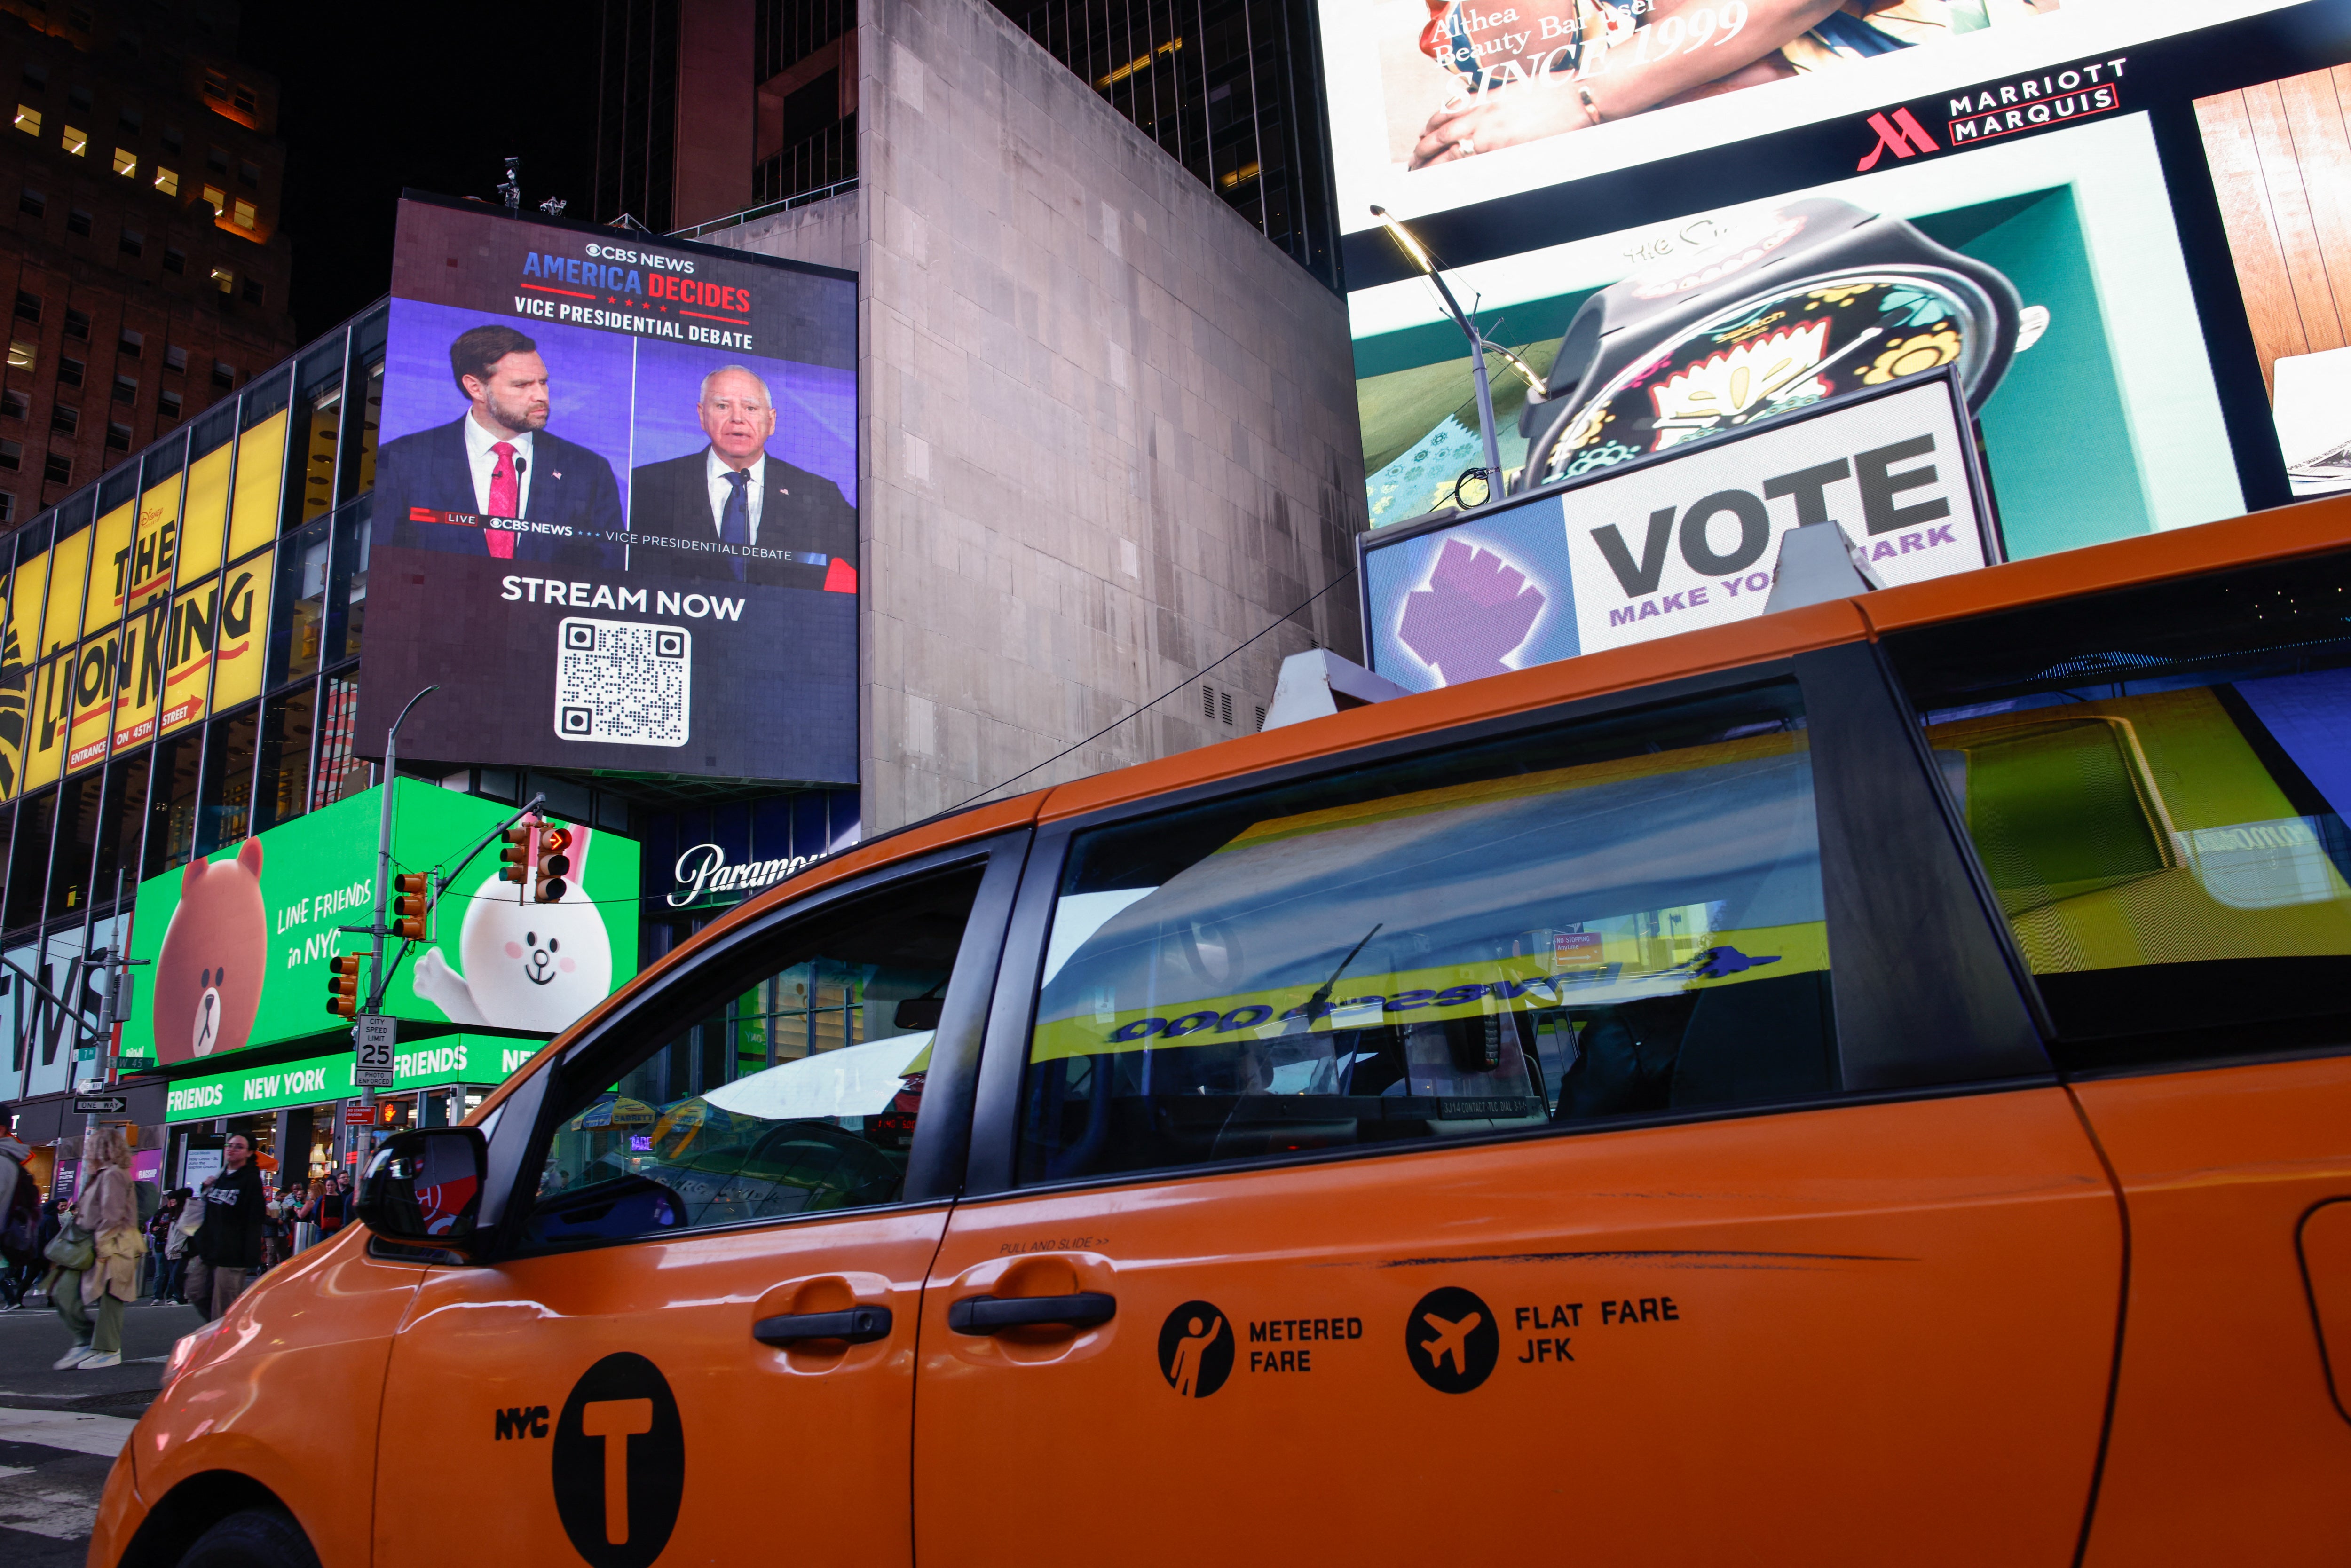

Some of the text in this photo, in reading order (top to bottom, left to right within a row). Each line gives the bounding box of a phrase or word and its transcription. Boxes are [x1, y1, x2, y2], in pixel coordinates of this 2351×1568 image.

[1430, 7, 1519, 43] Althea
[1432, 30, 1531, 69] Beauty
[1537, 16, 1588, 39] Bar
[1439, 0, 1749, 114] SINCE 1999
[1949, 58, 2126, 117] MARRIOTT
[1954, 89, 2113, 141] MARQUIS
[601, 246, 694, 274] CBS NEWS
[523, 252, 750, 313] AMERICA DECIDES
[514, 296, 753, 350] VICE PRESIDENTIAL DEBATE
[448, 514, 476, 525] LIVE
[1590, 433, 1952, 599] VOTE
[113, 519, 176, 597] THE
[502, 519, 793, 561] CBS NEWS VICE PRESIDENTIAL DEBATE
[500, 575, 746, 622] STREAM NOW
[1609, 586, 1710, 627] MAKE
[1720, 570, 1774, 598] YO
[39, 572, 254, 753] LION KING
[71, 705, 188, 765] ENTRANCE ON 45TH STREET
[277, 879, 371, 935] LINE FRIENDS
[287, 928, 341, 969] in NYC
[84, 1050, 88, 1059] 7
[119, 1059, 127, 1067] W
[132, 1059, 142, 1067] 45
[362, 1045, 389, 1064] 25
[392, 1045, 468, 1079] FRIENDS
[166, 1084, 223, 1112] FRIENDS
[243, 1075, 281, 1101] NEW
[284, 1067, 326, 1095] YORK
[1461, 1102, 1486, 1113] CONTACT
[1500, 1101, 1512, 1111] DIAL
[138, 1169, 157, 1179] FLAGSHIP
[1000, 1237, 1093, 1253] PULL AND SLIDE
[1249, 1317, 1363, 1342] METERED
[1515, 1296, 1680, 1330] FLAT FARE
[1250, 1350, 1311, 1373] FARE
[1517, 1338, 1575, 1363] JFK
[495, 1397, 653, 1545] NYC T
